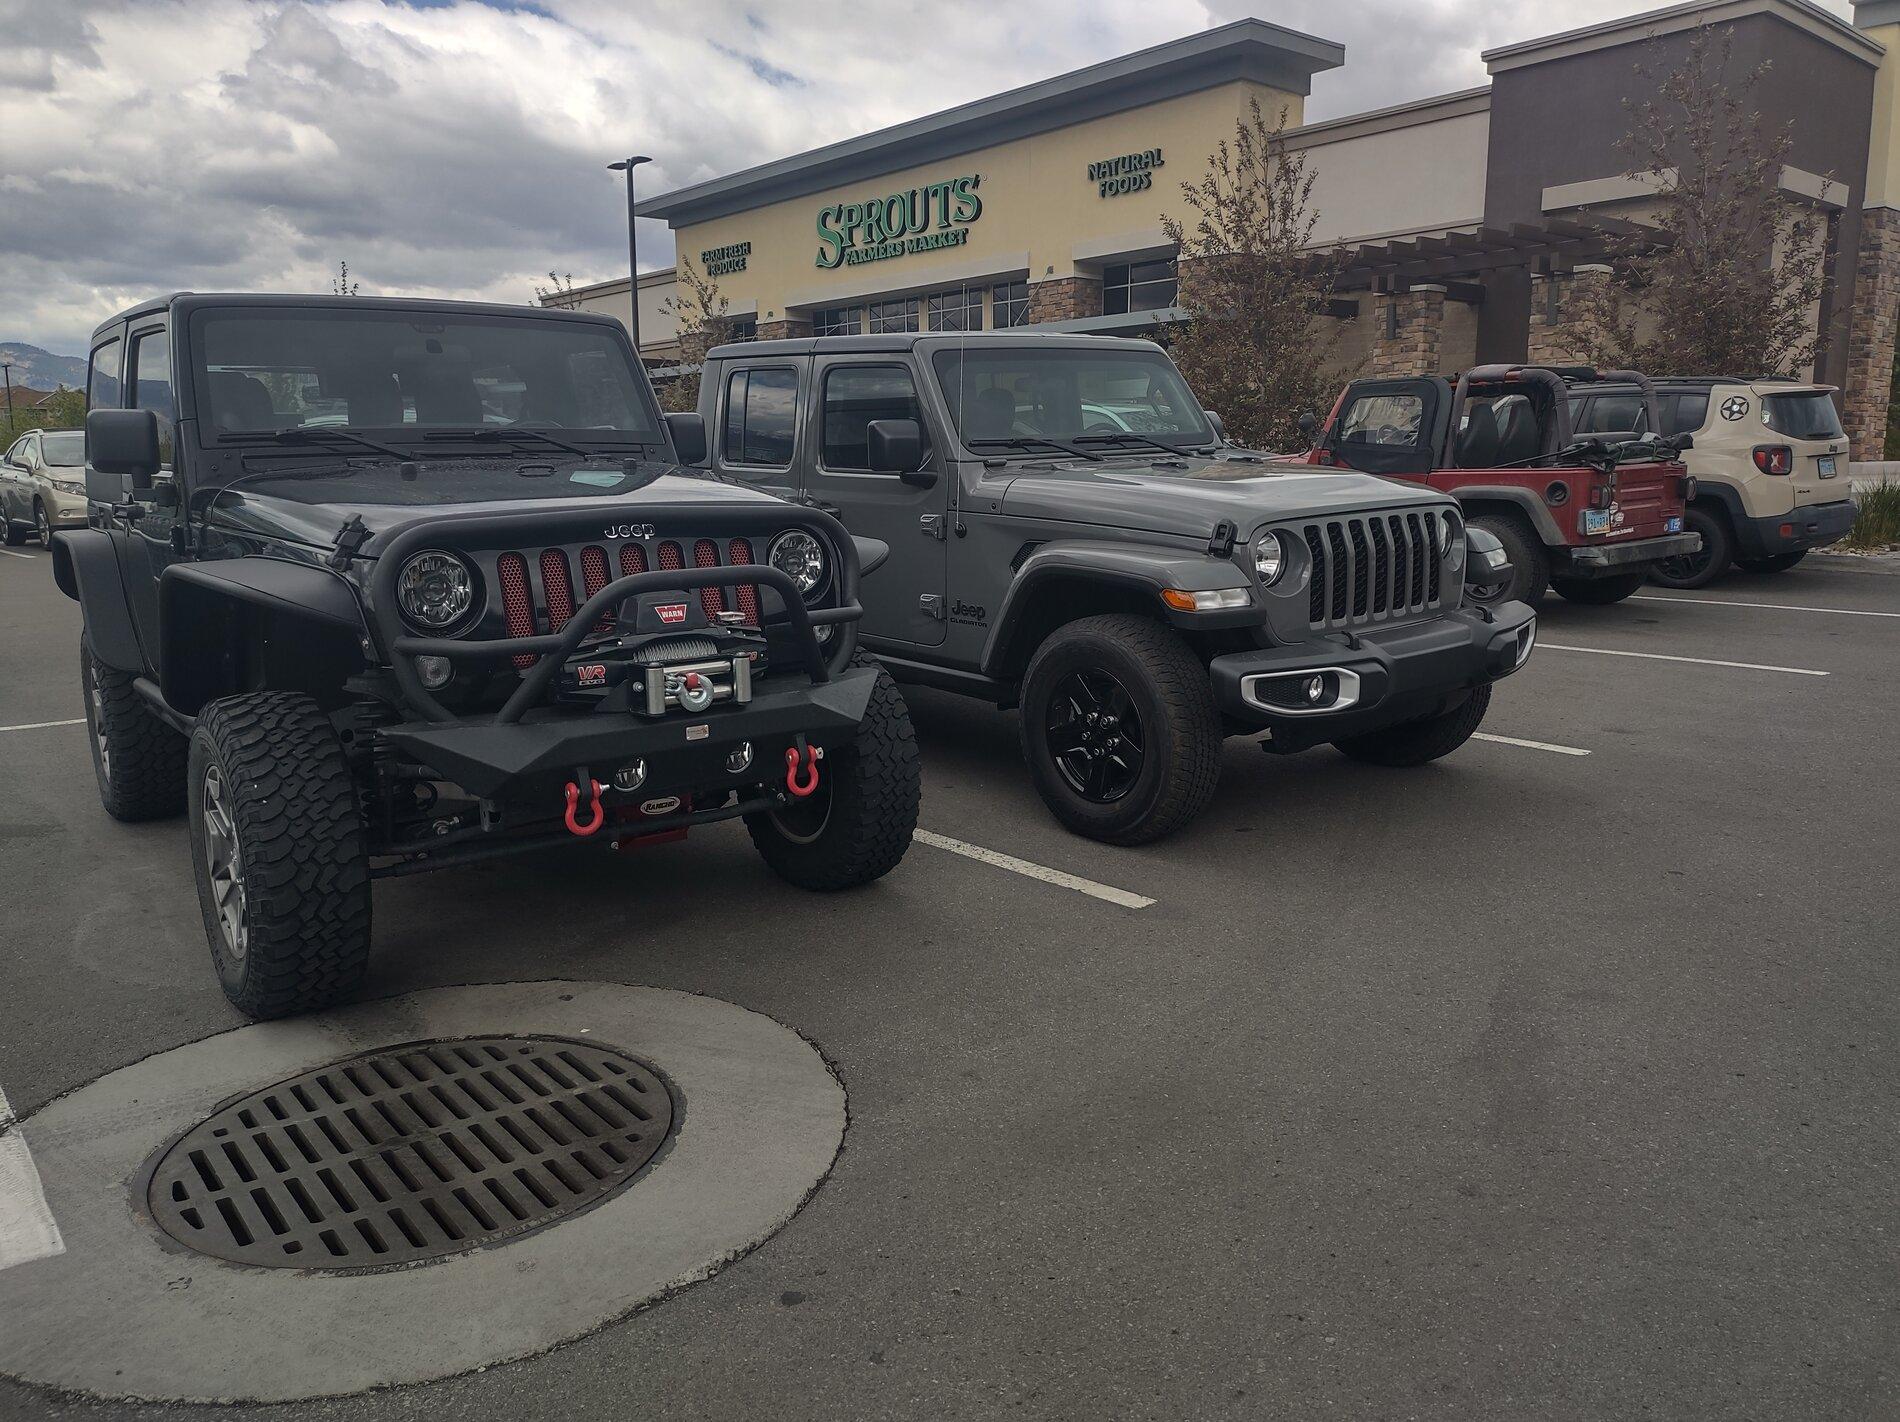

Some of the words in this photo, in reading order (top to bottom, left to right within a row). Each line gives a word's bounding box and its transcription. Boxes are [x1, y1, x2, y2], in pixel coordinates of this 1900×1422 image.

[1087, 148, 1164, 181] NATURAL
[1100, 172, 1152, 198] FOODS
[815, 174, 983, 268] SPROUTS
[701, 247, 725, 263] FARM
[725, 242, 751, 259] FRESH
[845, 240, 905, 265] FARMERS
[905, 228, 969, 255] MARKET
[604, 523, 656, 540] Jeep
[660, 608, 684, 620] WARN
[952, 599, 986, 621] Jeep
[577, 664, 606, 680] VR
[645, 800, 675, 811] RANCHO
